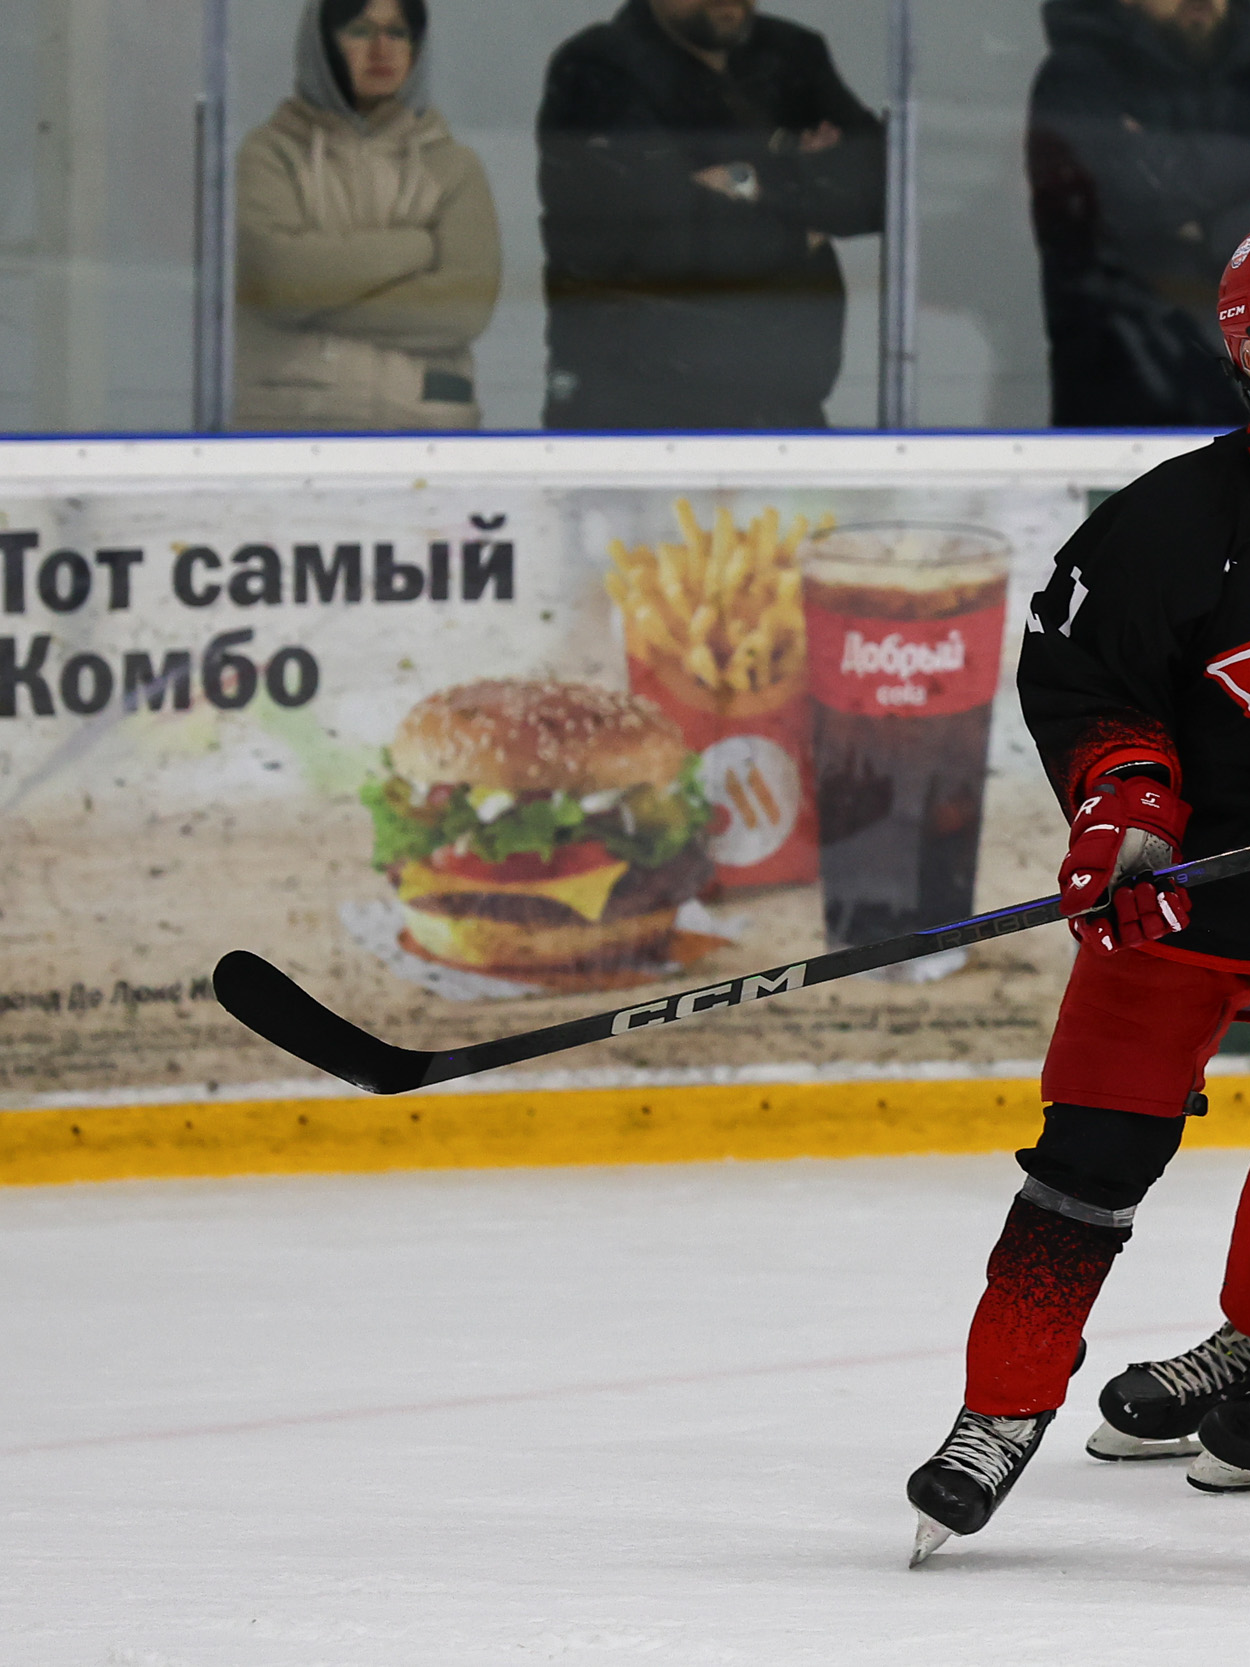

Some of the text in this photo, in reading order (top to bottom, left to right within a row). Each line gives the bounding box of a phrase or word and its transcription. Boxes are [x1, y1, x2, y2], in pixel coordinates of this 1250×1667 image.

[1218, 304, 1246, 321] CCM
[0, 513, 516, 616] Тот самый
[0, 627, 321, 718] Комбо
[841, 629, 966, 679] Добрый
[611, 963, 807, 1035] CCM
